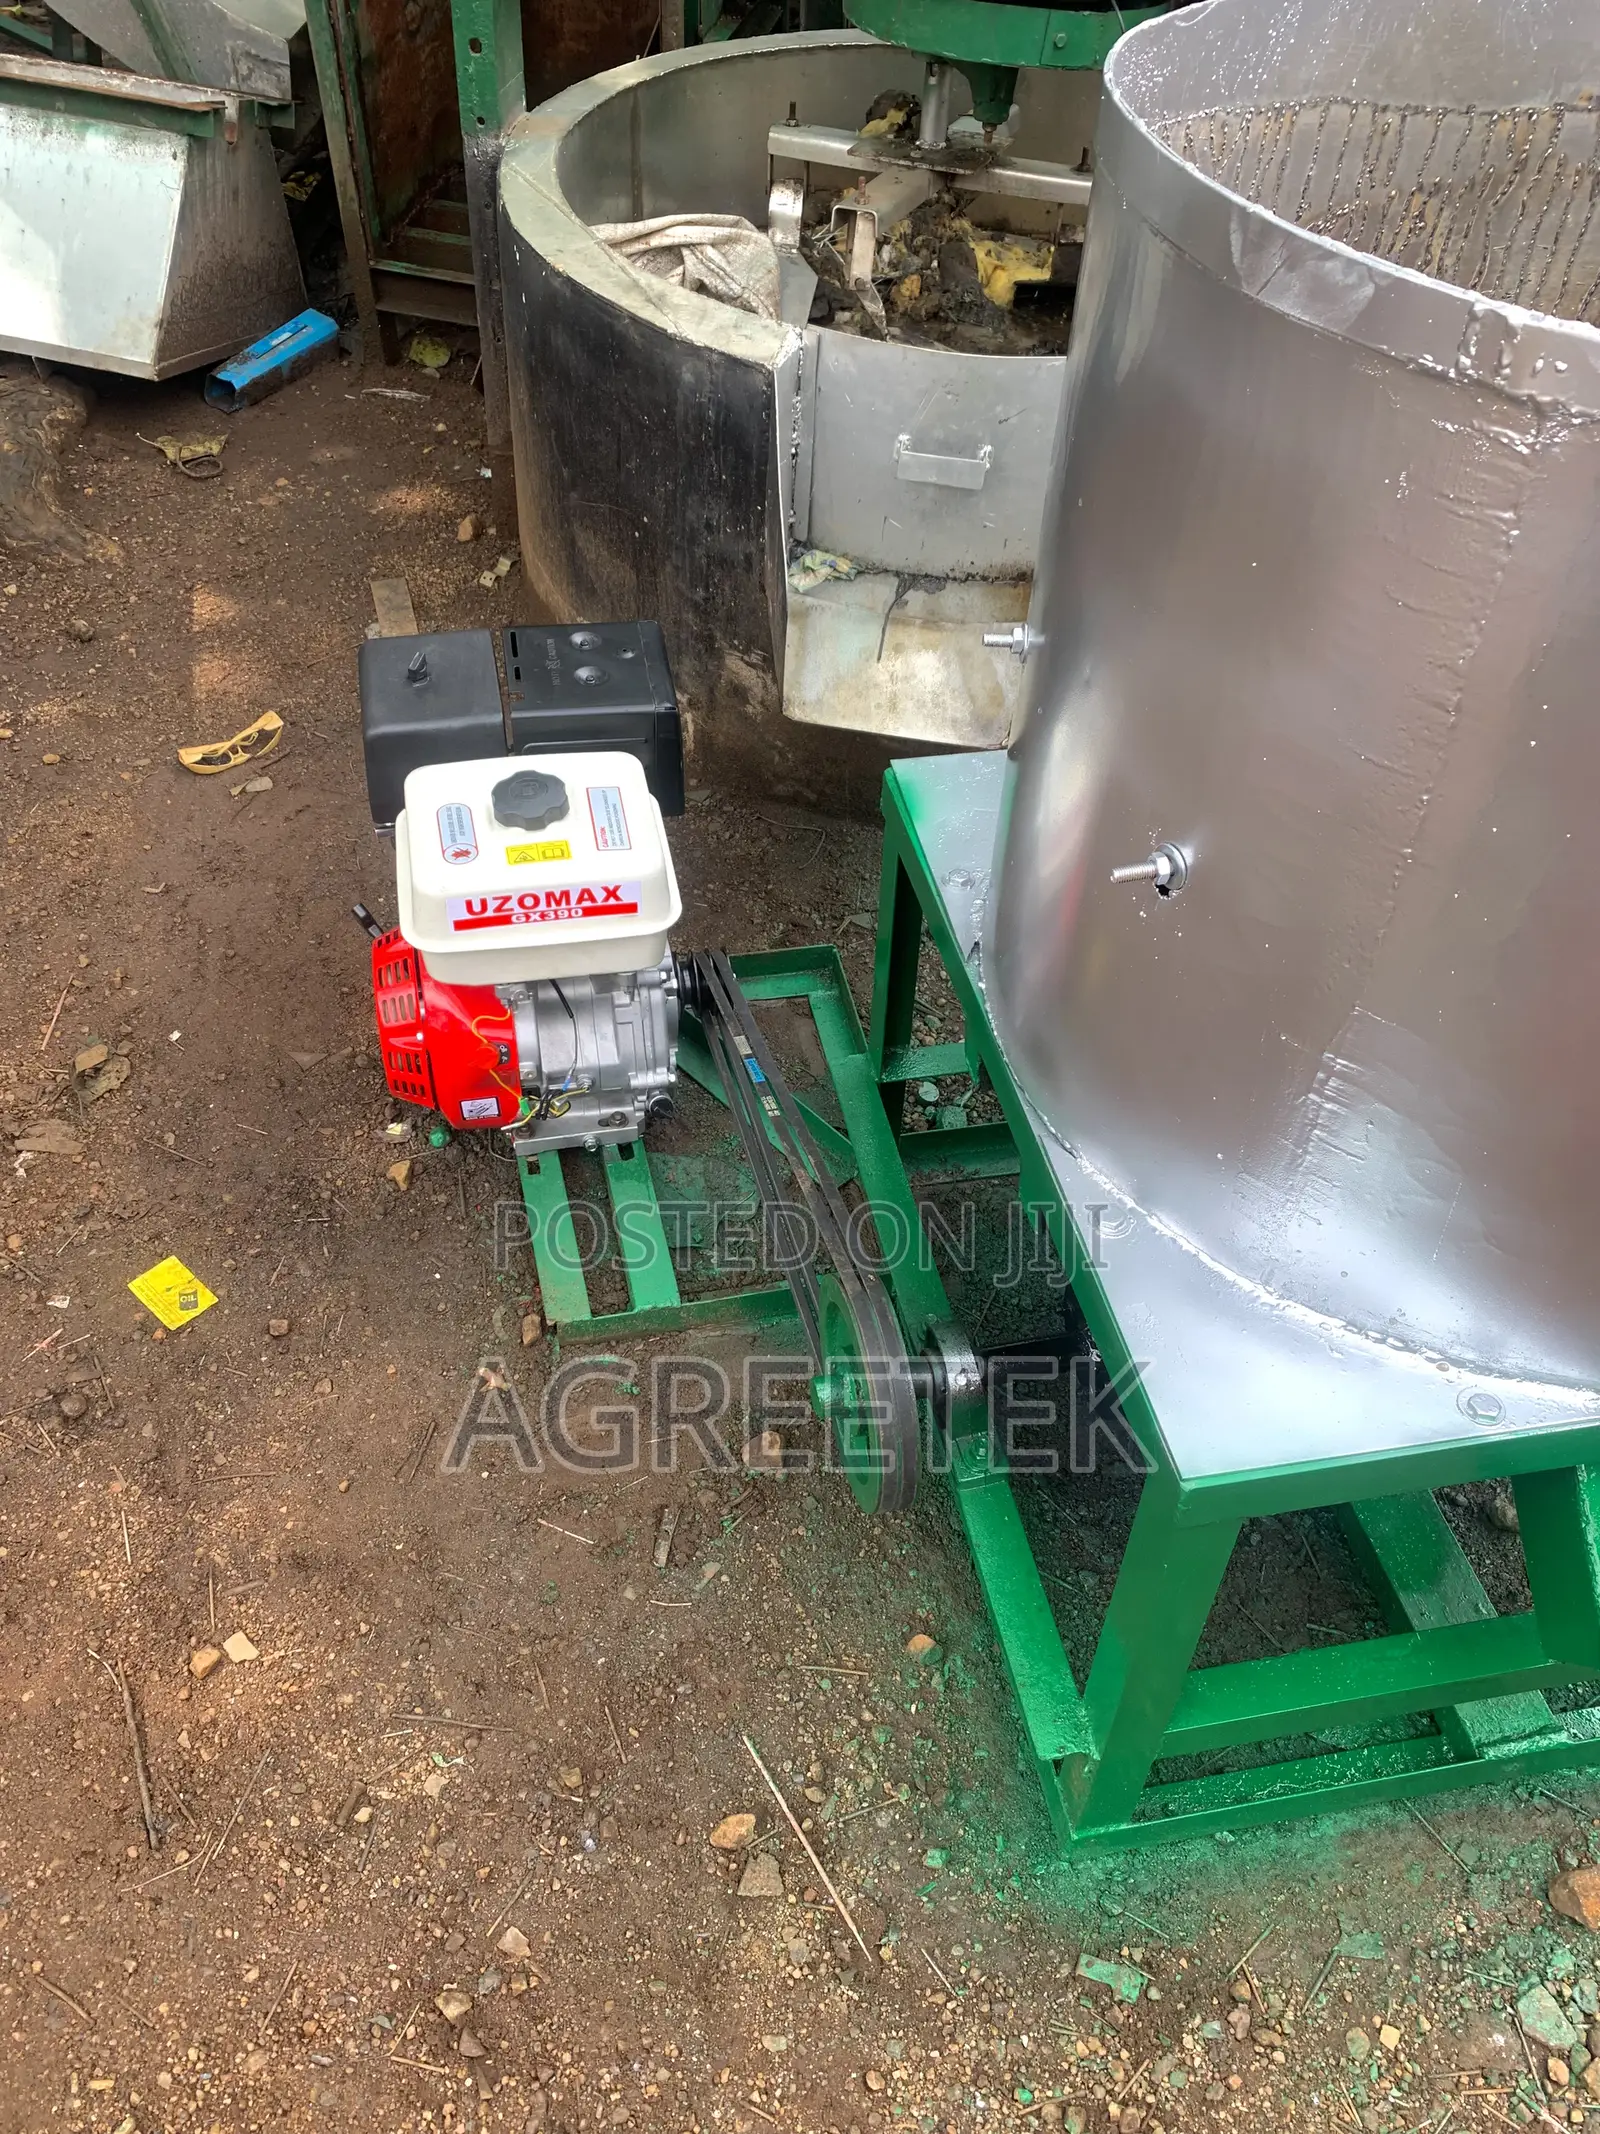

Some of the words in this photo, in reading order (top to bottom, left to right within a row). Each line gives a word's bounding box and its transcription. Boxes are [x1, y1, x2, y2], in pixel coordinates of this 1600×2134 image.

[465, 885, 623, 916] UZOMAX
[511, 908, 583, 924] GX390
[180, 1295, 197, 1303] OIL
